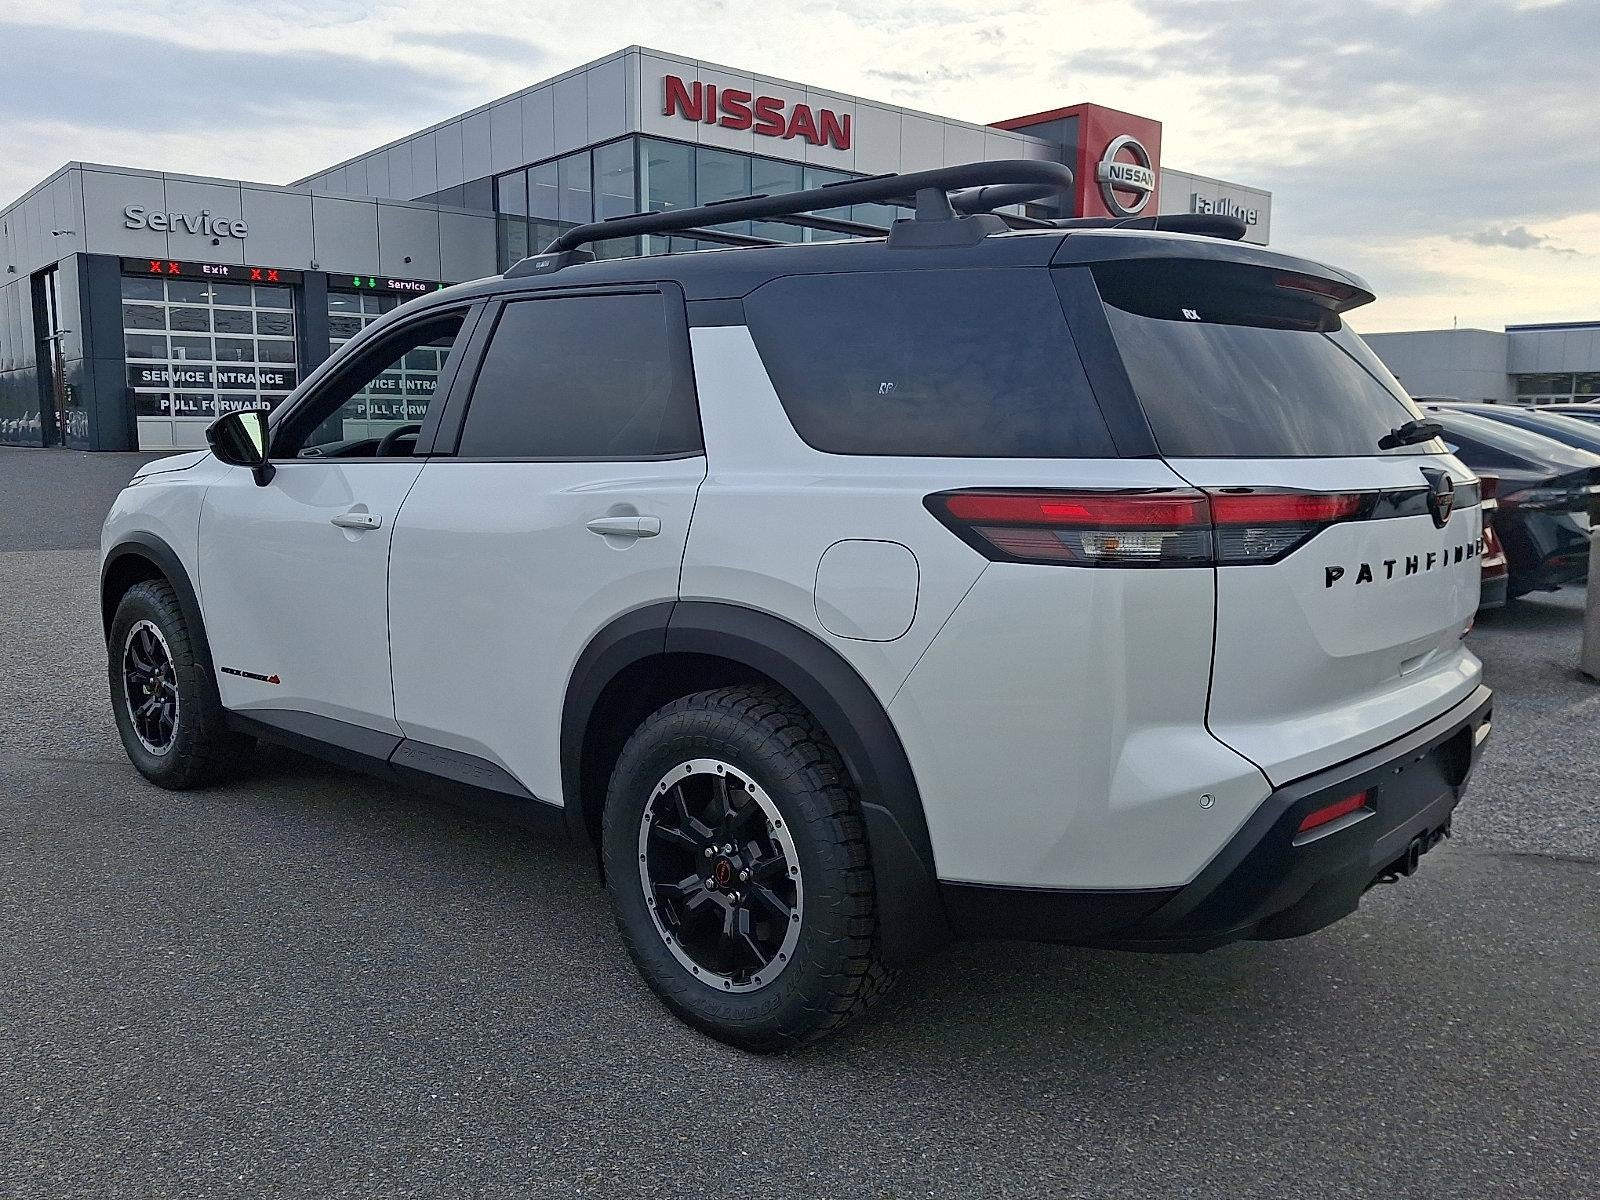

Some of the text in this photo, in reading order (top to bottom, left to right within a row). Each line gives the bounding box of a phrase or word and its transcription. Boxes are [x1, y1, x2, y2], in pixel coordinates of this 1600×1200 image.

[663, 75, 850, 150] NISSAN
[1110, 166, 1153, 187] NISSAN
[123, 204, 249, 239] Service
[202, 265, 229, 276] Exit
[388, 280, 425, 290] Service
[142, 370, 205, 382] SERVICE
[1325, 537, 1484, 588] PATHFINDE
